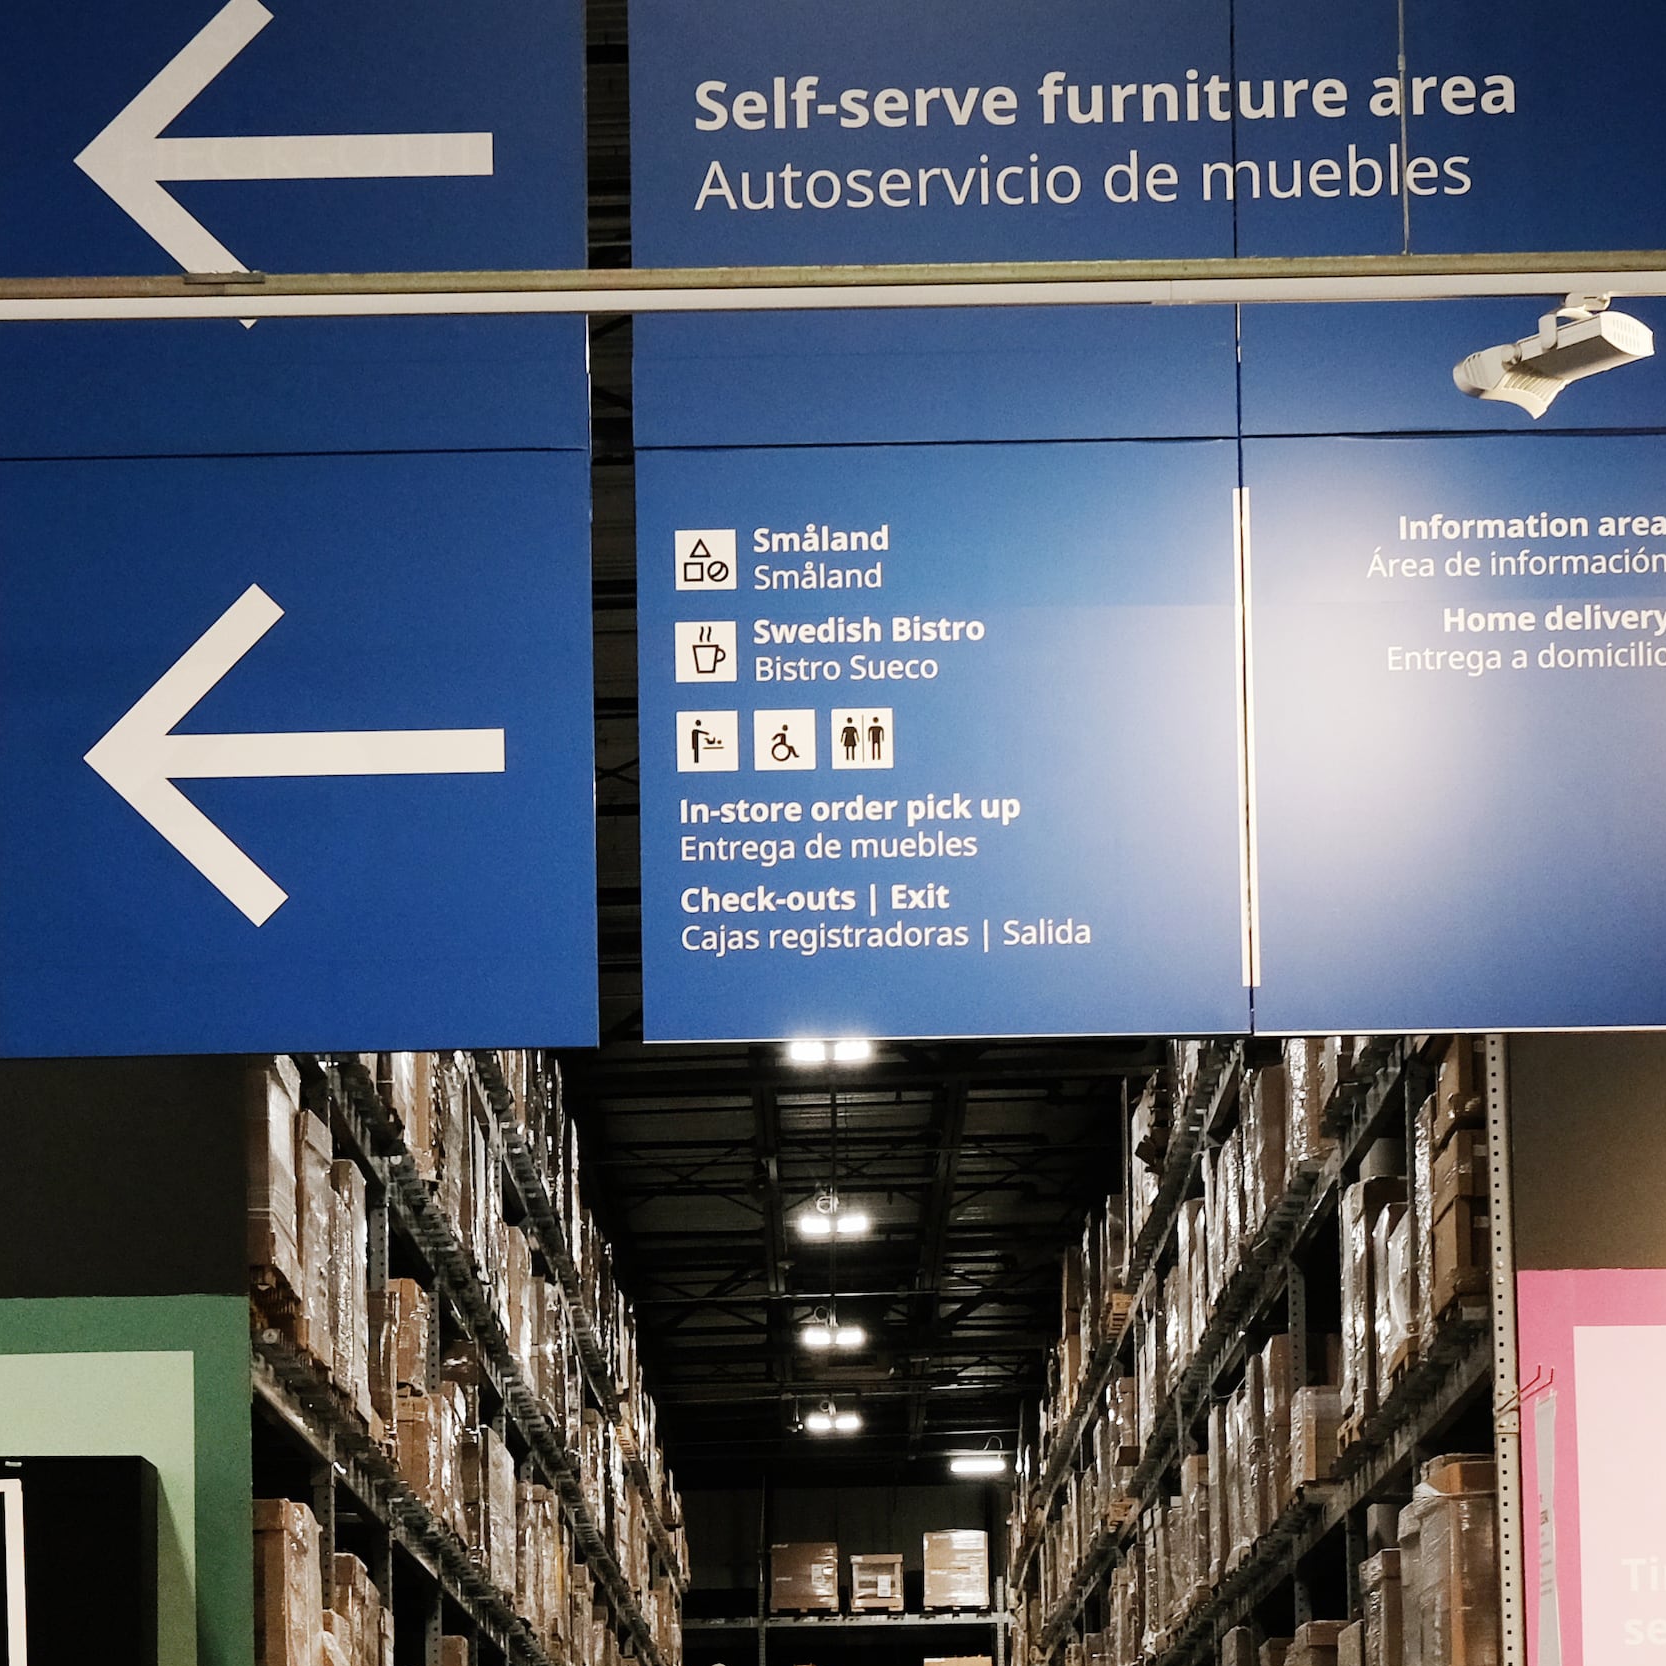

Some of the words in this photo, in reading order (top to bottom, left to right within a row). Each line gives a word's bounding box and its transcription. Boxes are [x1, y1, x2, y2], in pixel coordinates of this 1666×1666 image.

[693, 75, 1019, 132] Self-serve
[1037, 69, 1348, 126] furniture
[1368, 73, 1518, 116] area
[694, 151, 1083, 212] Autoservicio
[1104, 151, 1179, 203] de
[1203, 144, 1473, 201] muebles
[753, 524, 889, 553] Småland
[1399, 511, 1589, 540] Information
[753, 561, 882, 591] Småland
[1366, 546, 1434, 578] Área
[1444, 552, 1481, 576] de
[753, 616, 882, 645] Swedish
[891, 615, 986, 642] Bistro
[1443, 606, 1535, 633] Home
[754, 655, 841, 682] Bistro
[850, 654, 939, 680] Sueco
[1386, 646, 1503, 677] Entrega
[1512, 650, 1528, 669] a
[679, 798, 802, 825] In-store
[810, 795, 899, 822] order
[906, 793, 972, 826] pick
[980, 798, 1021, 825] up
[680, 834, 796, 867] Entrega
[804, 833, 842, 860] de
[851, 831, 978, 859] muebles
[680, 885, 856, 914] Check-outs
[891, 883, 950, 910] Exit
[681, 925, 760, 958] Cajas
[768, 922, 970, 956] registradoras
[1003, 918, 1091, 946] Salida
